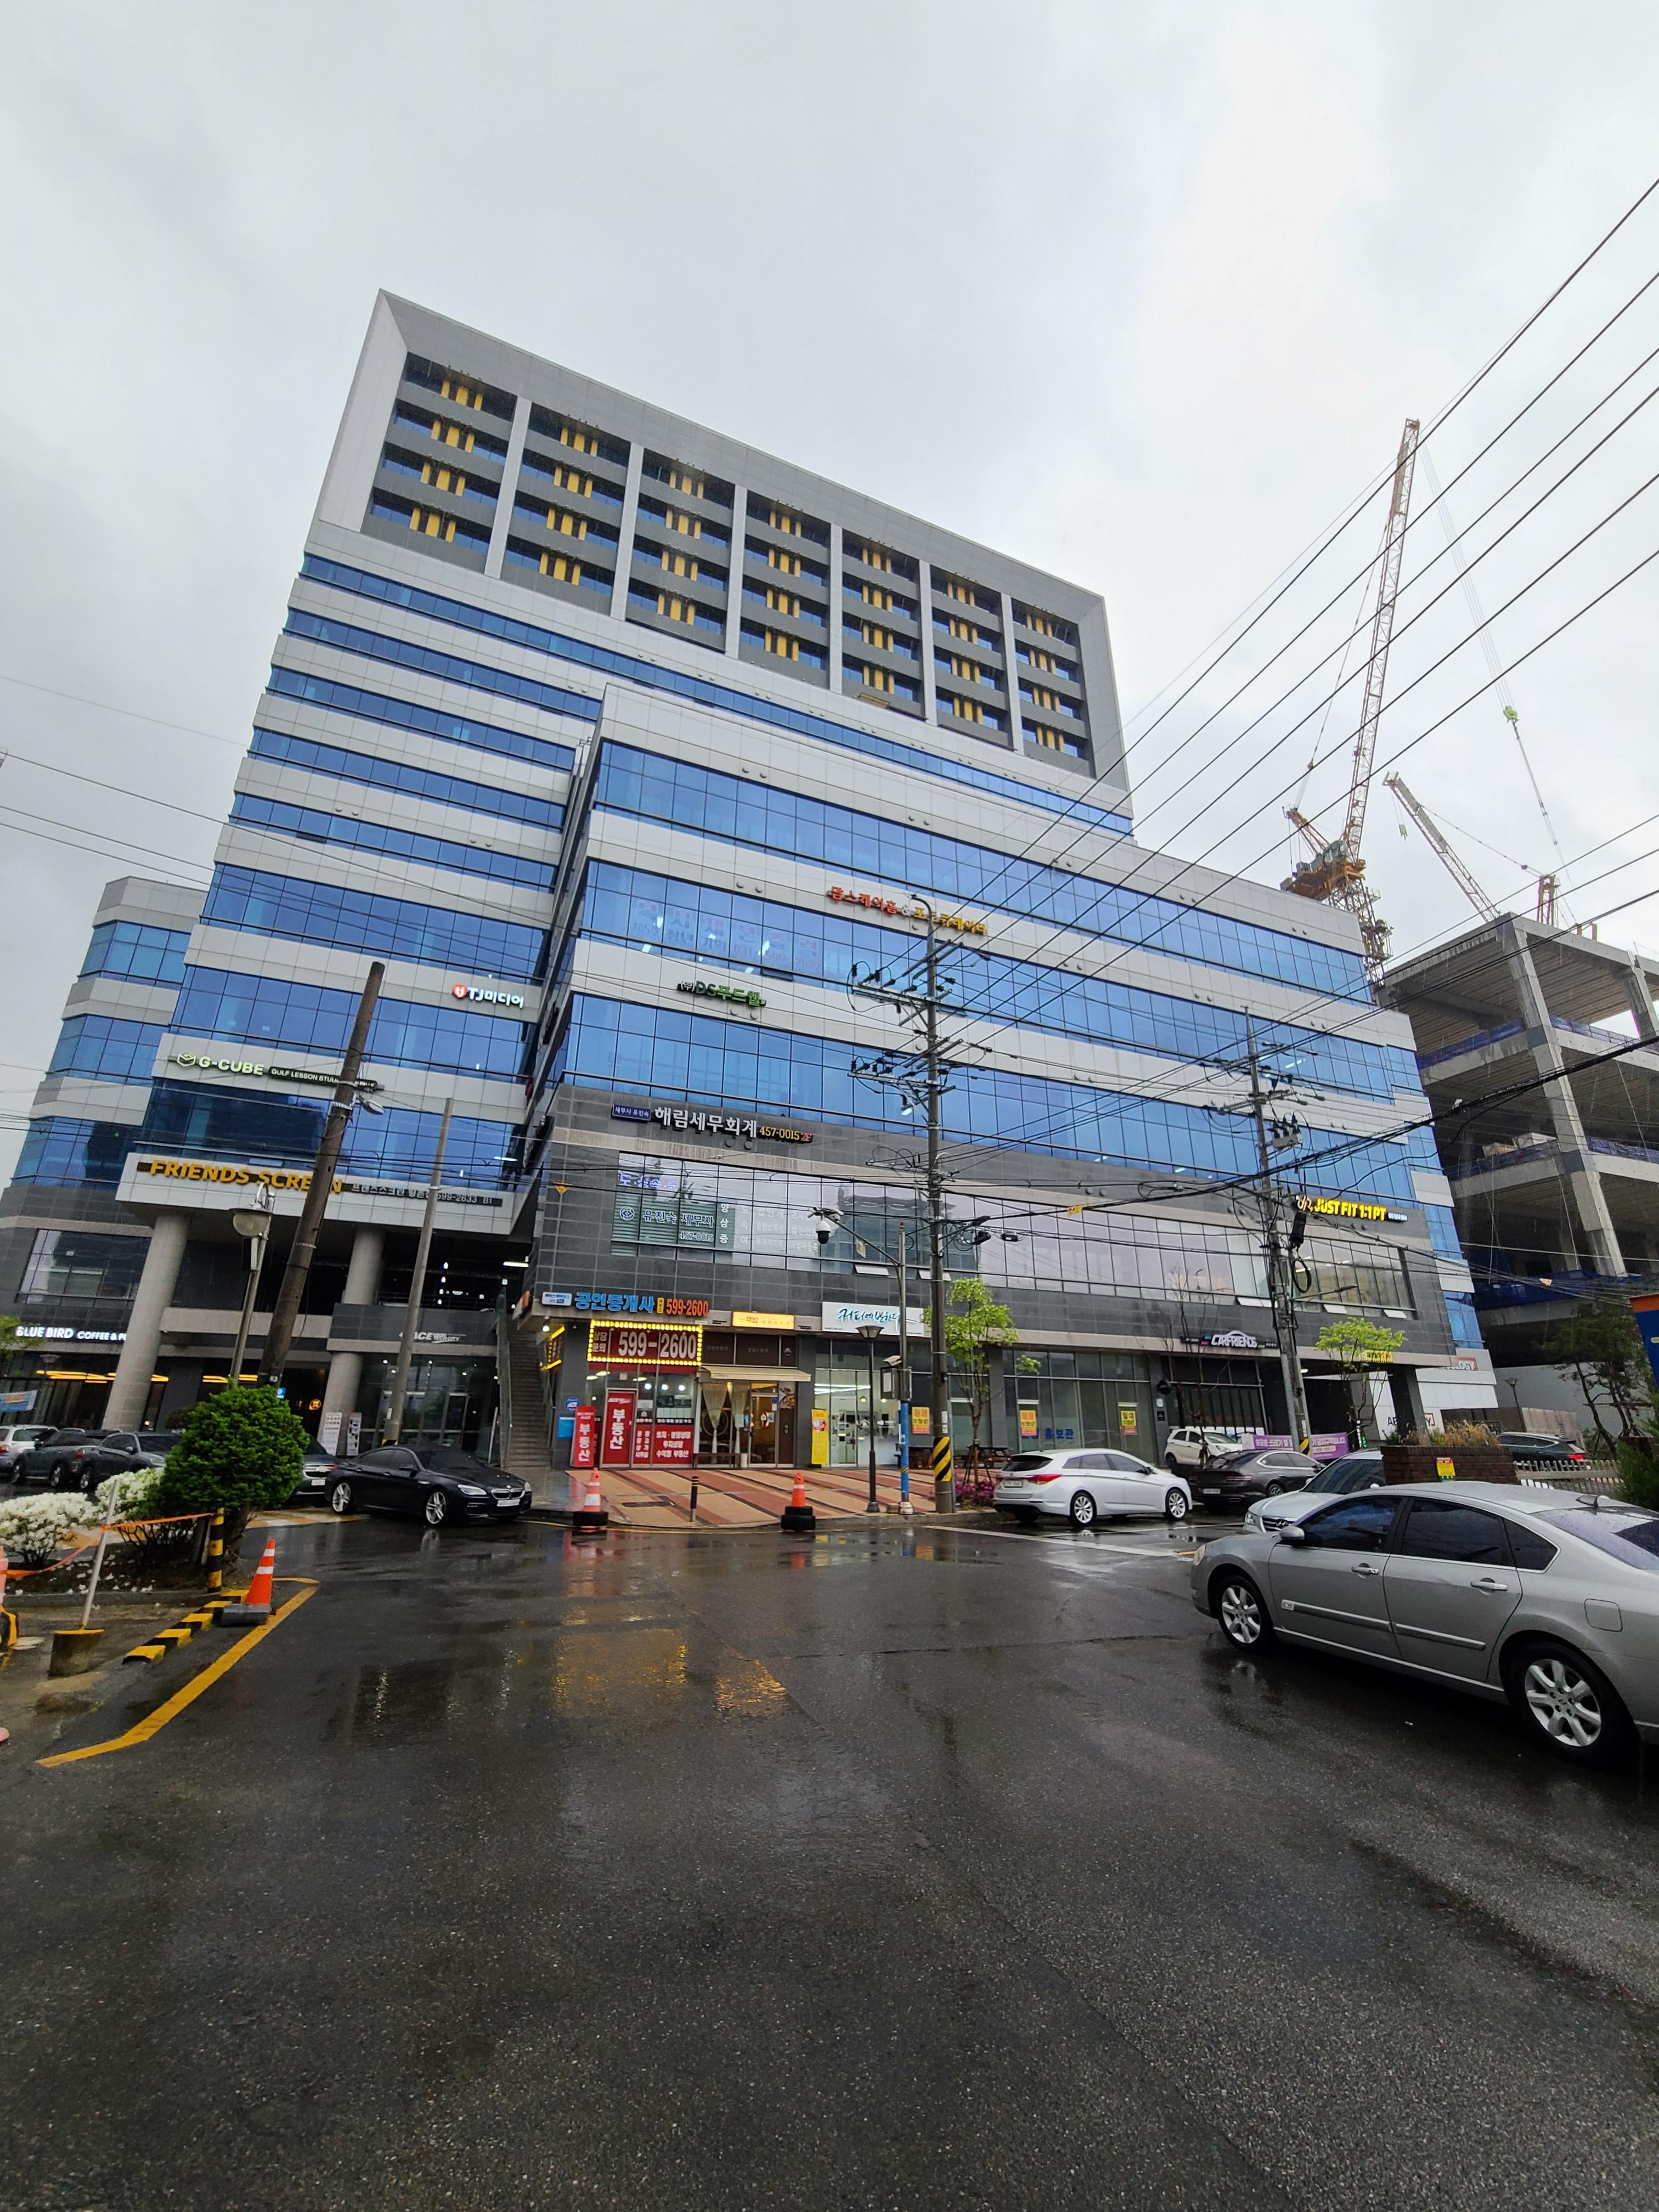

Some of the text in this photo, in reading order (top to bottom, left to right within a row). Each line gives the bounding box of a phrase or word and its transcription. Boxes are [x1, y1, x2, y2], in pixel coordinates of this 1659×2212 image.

[467, 986, 524, 1009] TJ미디어
[199, 1056, 264, 1076] G-CUBE
[271, 1068, 290, 1076] GOLF
[291, 1070, 318, 1081] LESSON
[615, 1107, 631, 1115] 세무사
[654, 1107, 757, 1138] 해림세무회계
[150, 1159, 343, 1193] FRIENDS SCREN
[642, 1209, 714, 1228] 유진숙 세무사
[1315, 1197, 1340, 1215] JUST
[1341, 1202, 1358, 1217] FIT
[1373, 1206, 1387, 1221] PT
[574, 1291, 654, 1314] 공인중개사
[666, 1298, 710, 1317] 599-2600
[15, 1325, 45, 1338] BLUE
[46, 1327, 75, 1339] BIRD
[76, 1331, 110, 1341] COFFEE
[618, 1331, 697, 1359] 599-2600
[610, 1408, 626, 1450] 부동산
[578, 1423, 591, 1462] 부동산
